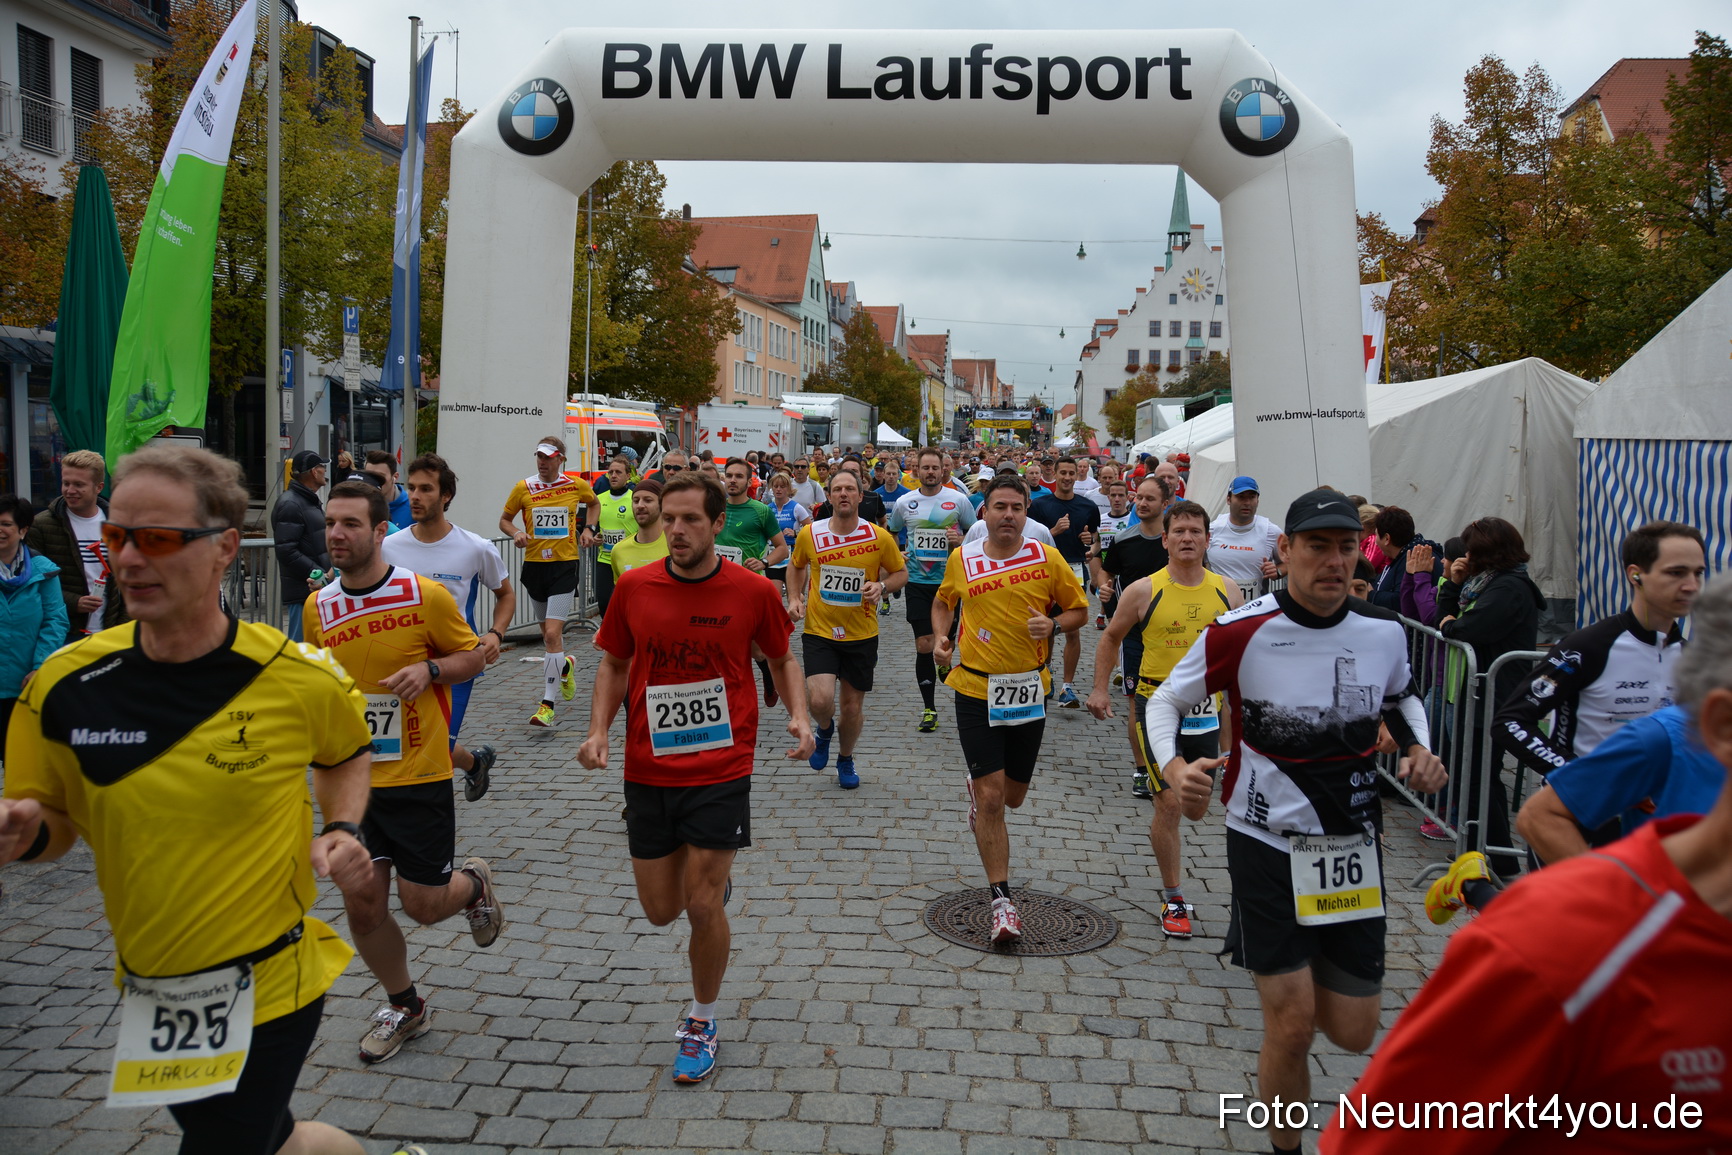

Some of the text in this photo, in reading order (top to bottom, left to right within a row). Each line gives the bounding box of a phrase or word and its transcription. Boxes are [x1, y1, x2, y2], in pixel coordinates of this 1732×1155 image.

[601, 43, 1193, 115] BMW Laufsport
[508, 80, 569, 105] BMW
[1226, 79, 1291, 105] BMW
[173, 215, 196, 235] leben.
[346, 306, 355, 329] P
[285, 355, 292, 383] P
[307, 402, 314, 414] 3
[440, 402, 543, 416] www.bmw-laufsport.de
[1256, 408, 1366, 422] www.bmw-laufsport.de
[531, 485, 579, 502] MAX BÖGL
[536, 514, 565, 527] 2731
[917, 536, 946, 549] 2126
[817, 544, 880, 565] MAX BÖGL
[824, 574, 861, 592] 2760
[968, 569, 1050, 598] MAX BÖGL
[324, 612, 425, 648] MAX BÖGL
[689, 616, 719, 625] swn
[1010, 676, 1033, 684] Neumarkt
[648, 687, 711, 700] PARTL Neumarkt
[994, 684, 1039, 706] 2787
[228, 711, 255, 722] TSV
[656, 697, 722, 729] 2385
[1003, 709, 1031, 719] Dietmar
[364, 711, 394, 736] 67
[70, 728, 148, 745] Markus
[674, 730, 709, 744] Fabian
[1526, 736, 1571, 767] Trizo
[205, 752, 270, 774] Burgthann
[1293, 839, 1362, 853] PARTL Neumarkt
[1312, 852, 1363, 889] 156
[1317, 893, 1361, 911] Michael
[151, 1001, 228, 1053] 525
[137, 1058, 236, 1085] MARKUS
